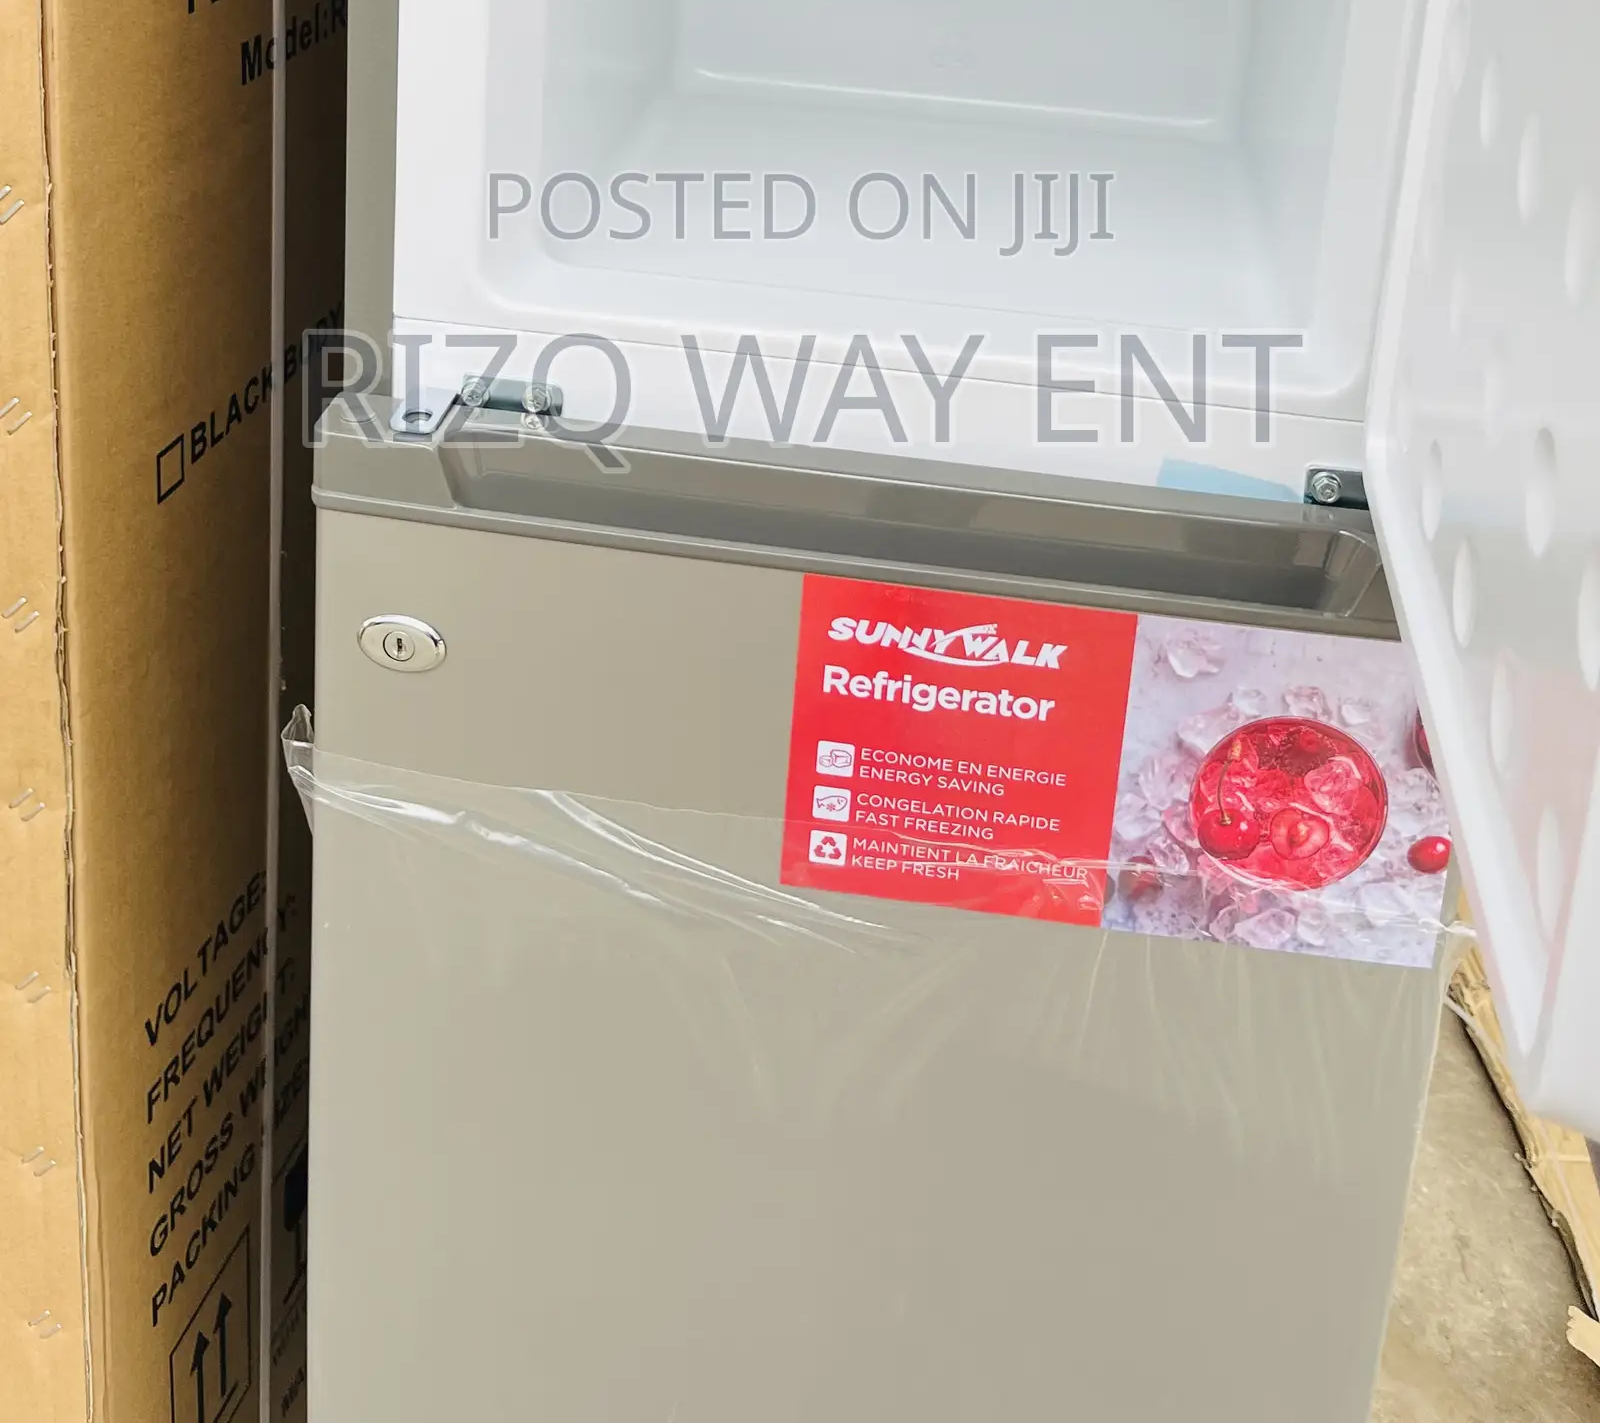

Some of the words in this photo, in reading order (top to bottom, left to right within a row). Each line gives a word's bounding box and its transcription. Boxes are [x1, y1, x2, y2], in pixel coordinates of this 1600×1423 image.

[191, 362, 273, 465] BLACK
[828, 616, 1068, 669] SUNNYWALK
[823, 665, 1055, 721] Refrigerator
[859, 767, 932, 787] ENERGY
[938, 777, 1005, 796] SAVING
[861, 748, 953, 773] ECONOME
[958, 761, 982, 775] EN
[987, 765, 1067, 787] ENERGIE
[855, 812, 897, 827] FAST
[904, 817, 994, 840] FREEZING
[857, 793, 989, 821] CONGELATION
[993, 812, 1060, 832] RAPIDE
[852, 856, 897, 871] KEEP
[902, 861, 959, 880] FRESH
[853, 838, 951, 862] MAINTIENT
[956, 851, 979, 866] LA
[148, 1097, 197, 1194] NET
[150, 1112, 234, 1257] GROSS
[152, 1143, 255, 1328] PACKING
